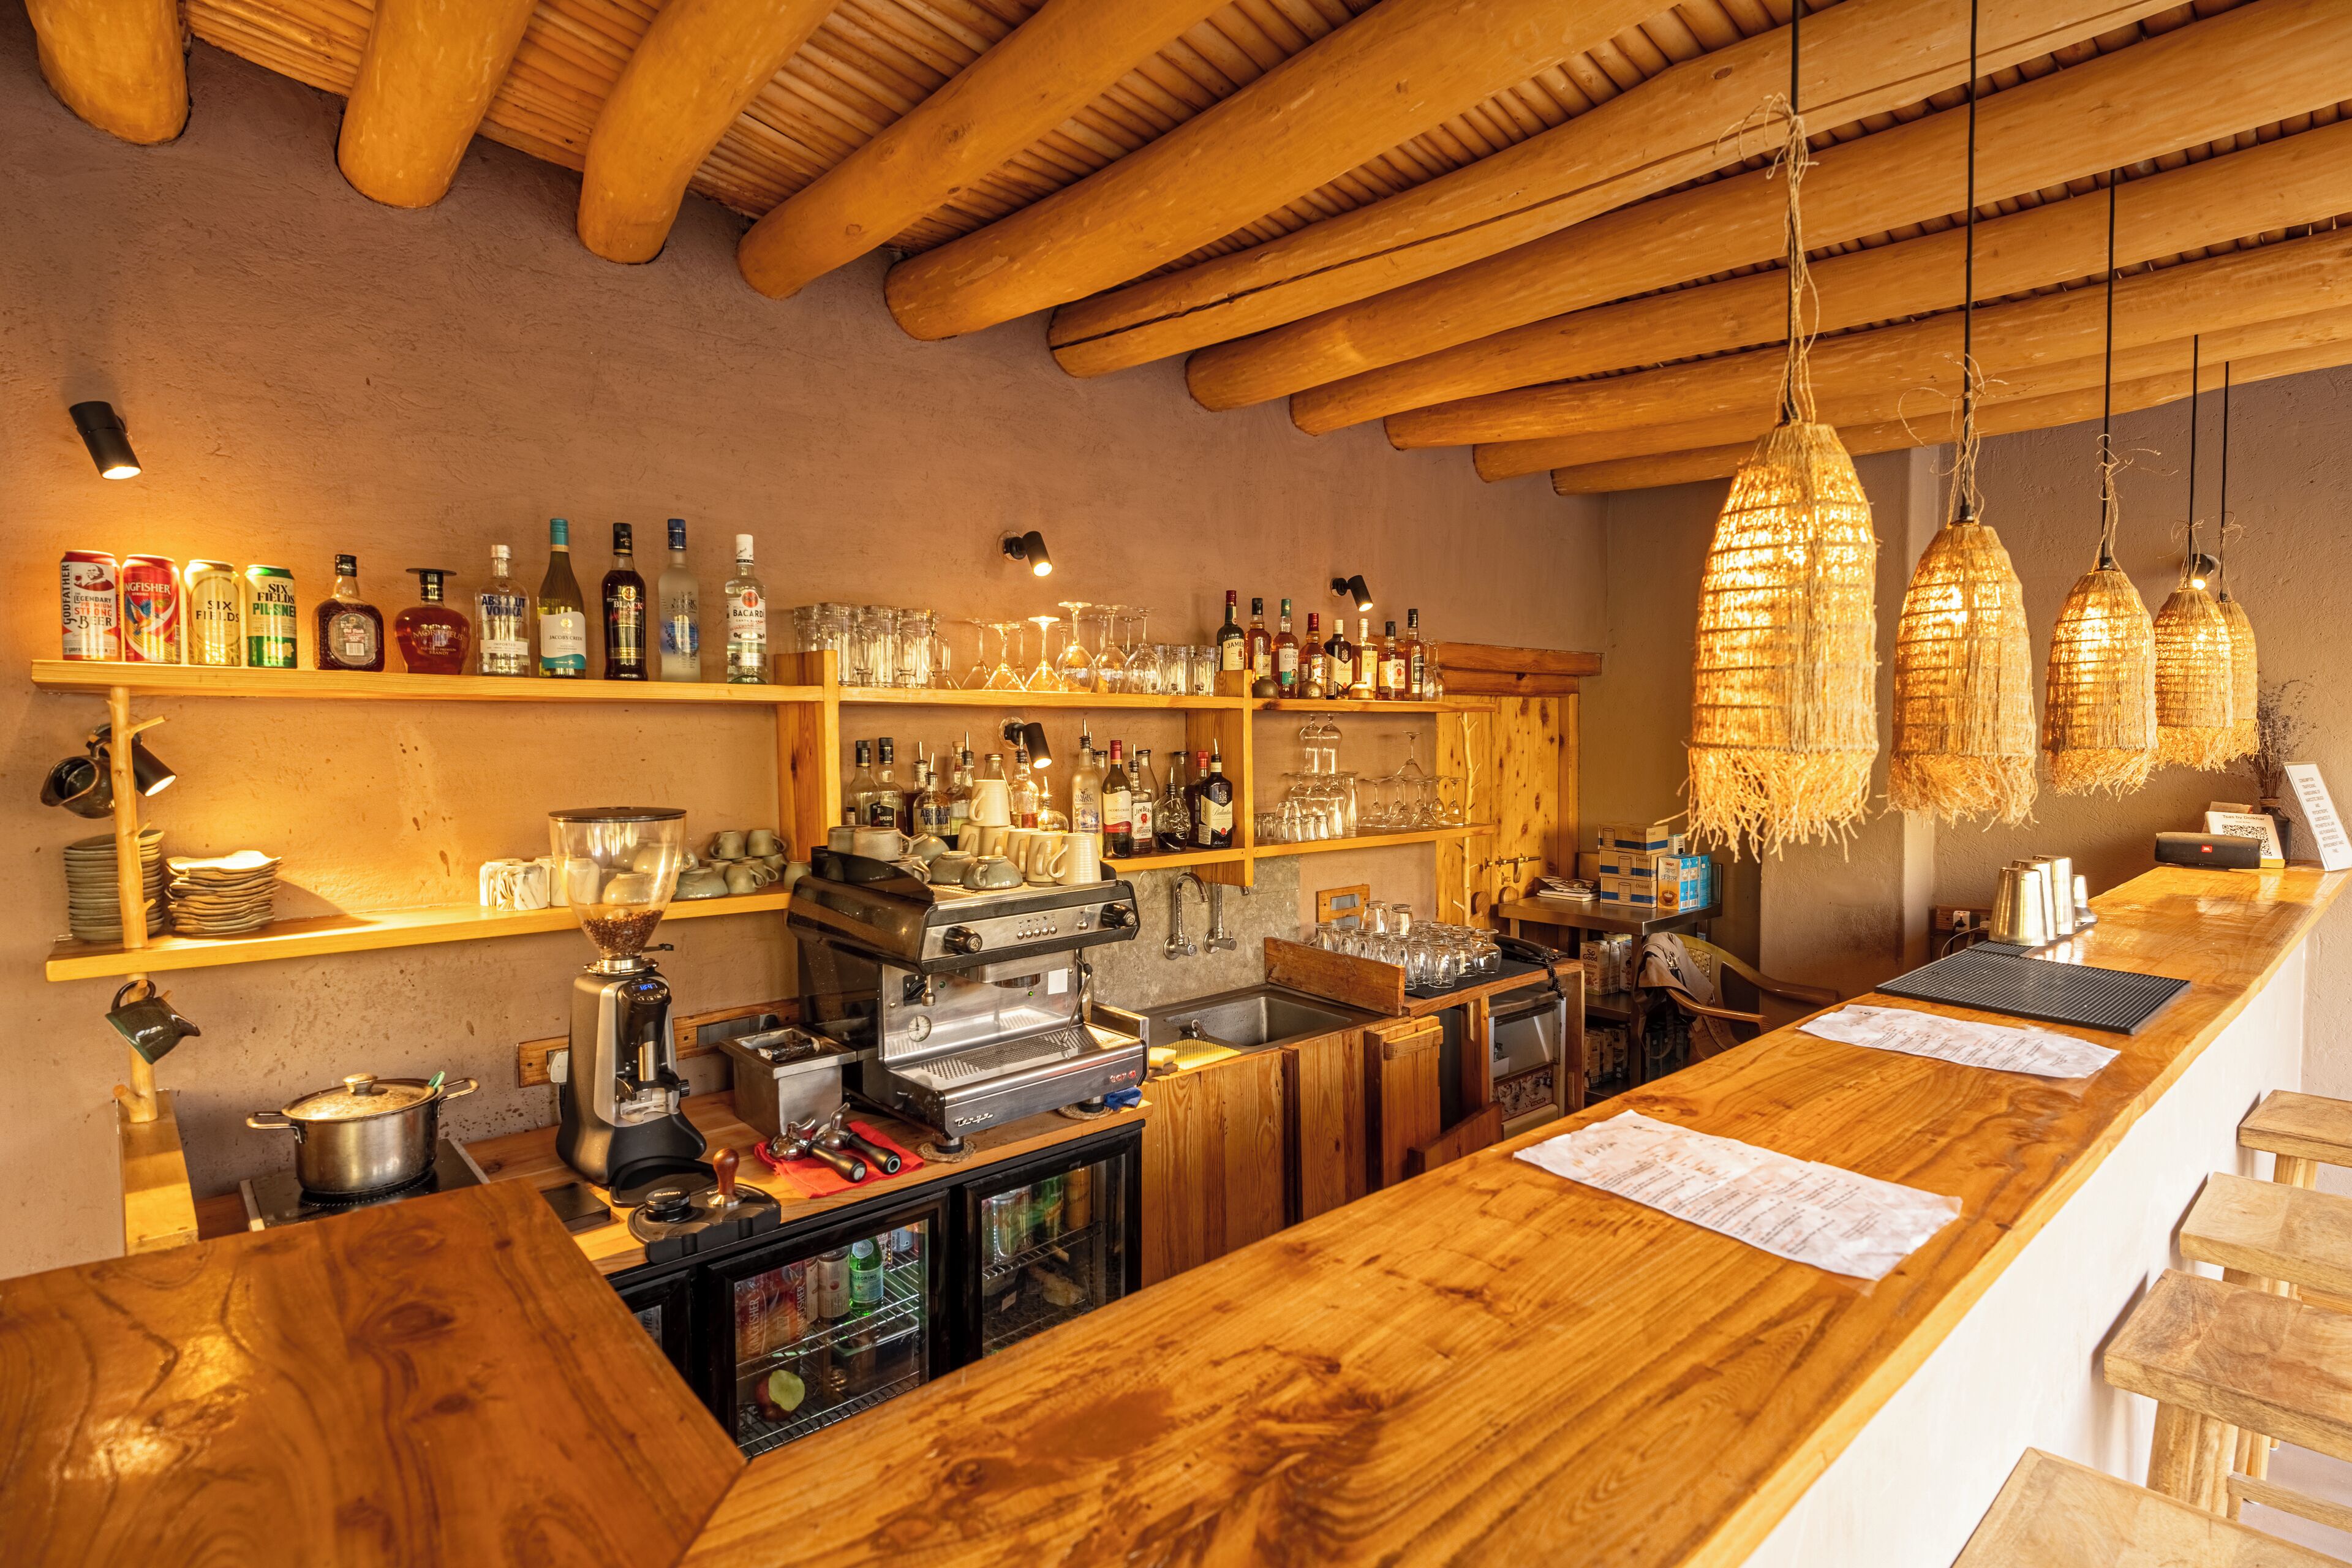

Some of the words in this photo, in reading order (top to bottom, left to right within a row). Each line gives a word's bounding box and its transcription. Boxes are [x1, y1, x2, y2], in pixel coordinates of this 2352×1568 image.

[62, 564, 77, 625] GODFATHER
[124, 582, 172, 595] NGFISHER
[268, 584, 287, 594] SIX
[74, 595, 111, 604] LEGENDARY
[257, 592, 295, 605] FIELDS
[481, 595, 526, 608] ABSOLUT
[208, 600, 232, 611] SIX
[486, 606, 522, 617] VODKA
[75, 608, 112, 616] STRONG
[196, 611, 239, 622] FIELDS
[78, 616, 112, 629] BEER
[921, 809, 950, 818] ABSOLUT
[797, 1281, 805, 1340] KINGFISHER
[748, 1296, 760, 1355] KINGFISHER
